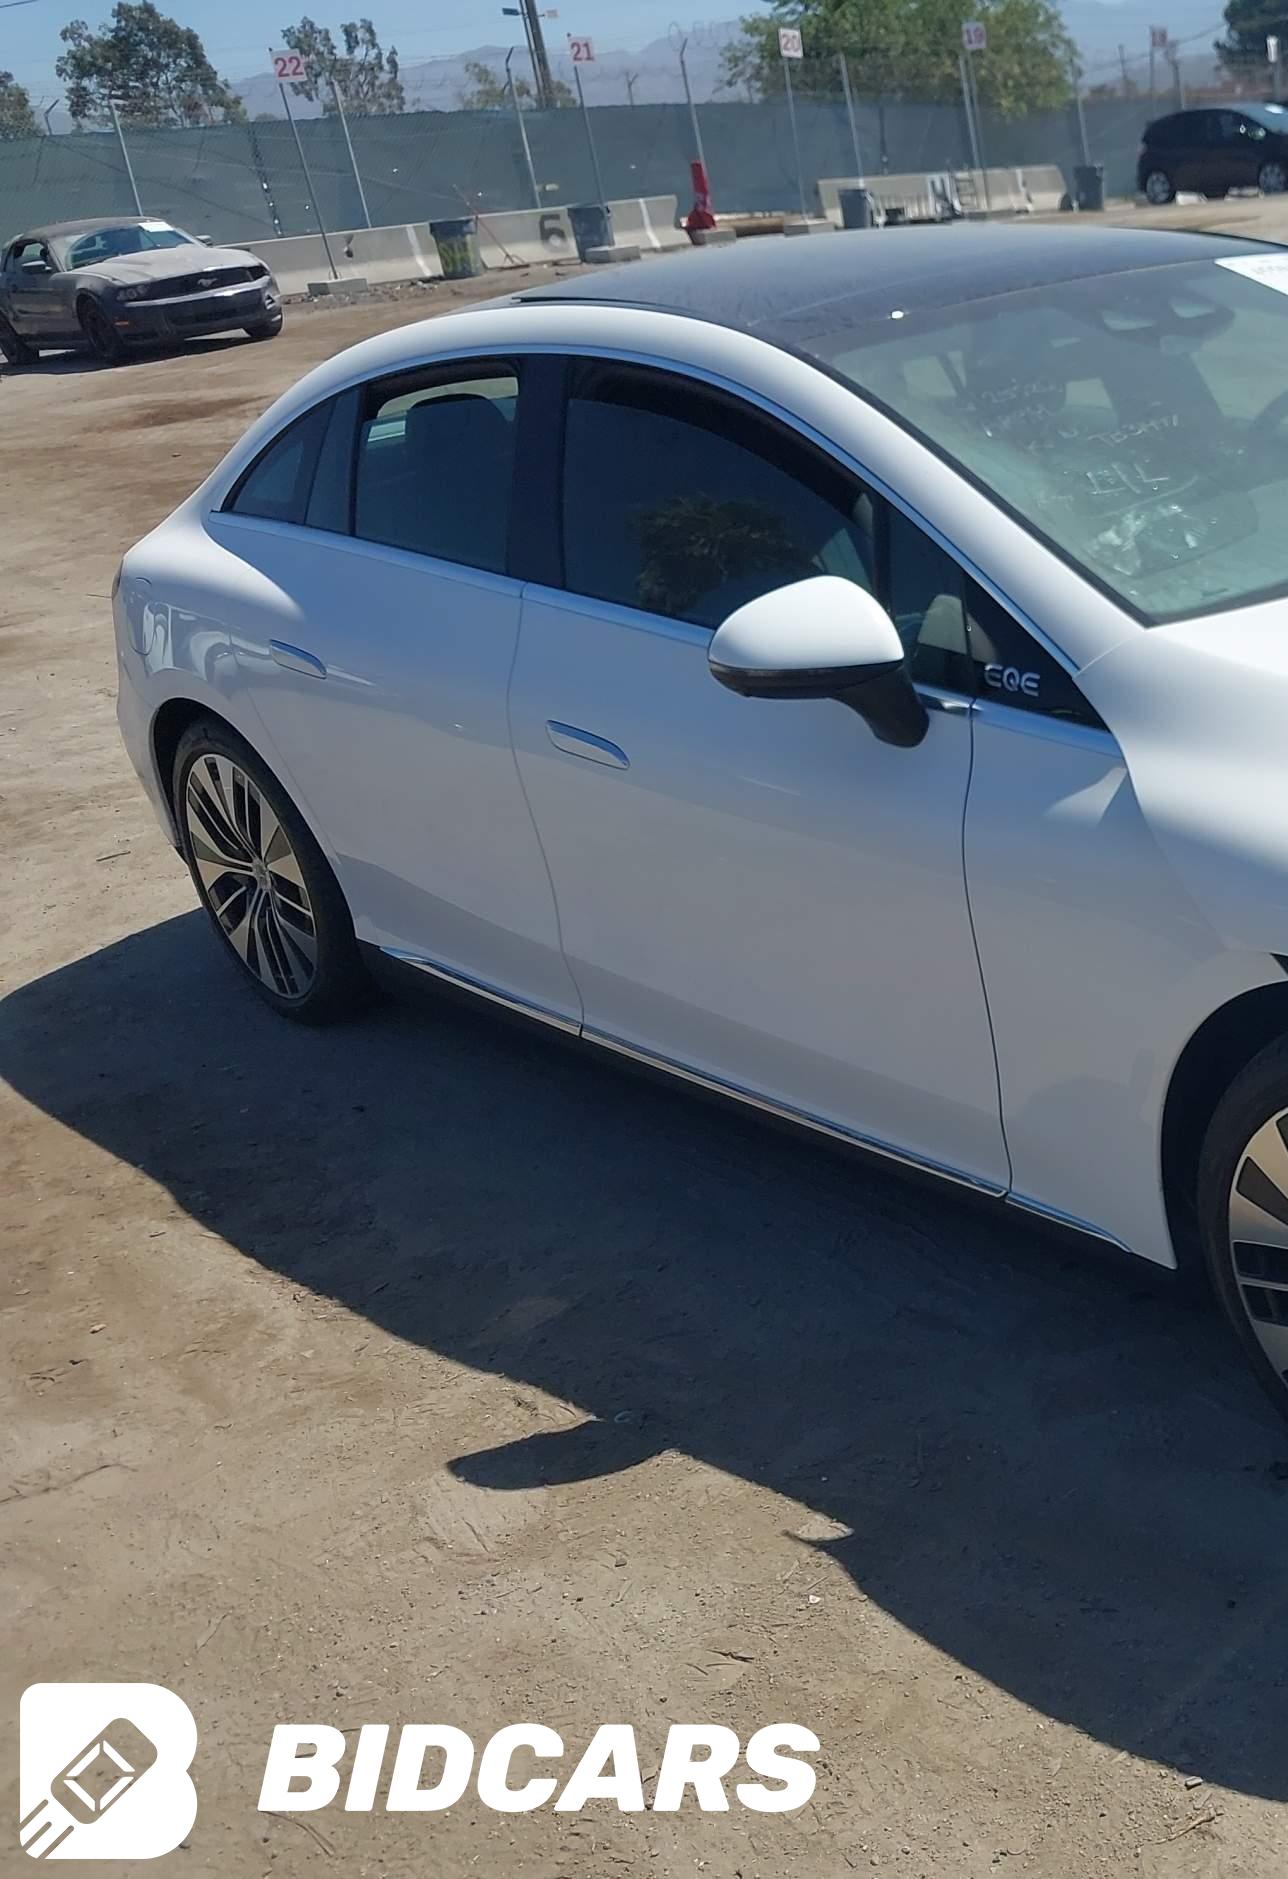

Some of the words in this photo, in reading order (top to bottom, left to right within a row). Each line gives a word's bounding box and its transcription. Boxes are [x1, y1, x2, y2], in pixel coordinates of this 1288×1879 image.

[570, 41, 594, 61] 21
[274, 56, 304, 77] 22
[984, 664, 1041, 697] EQE
